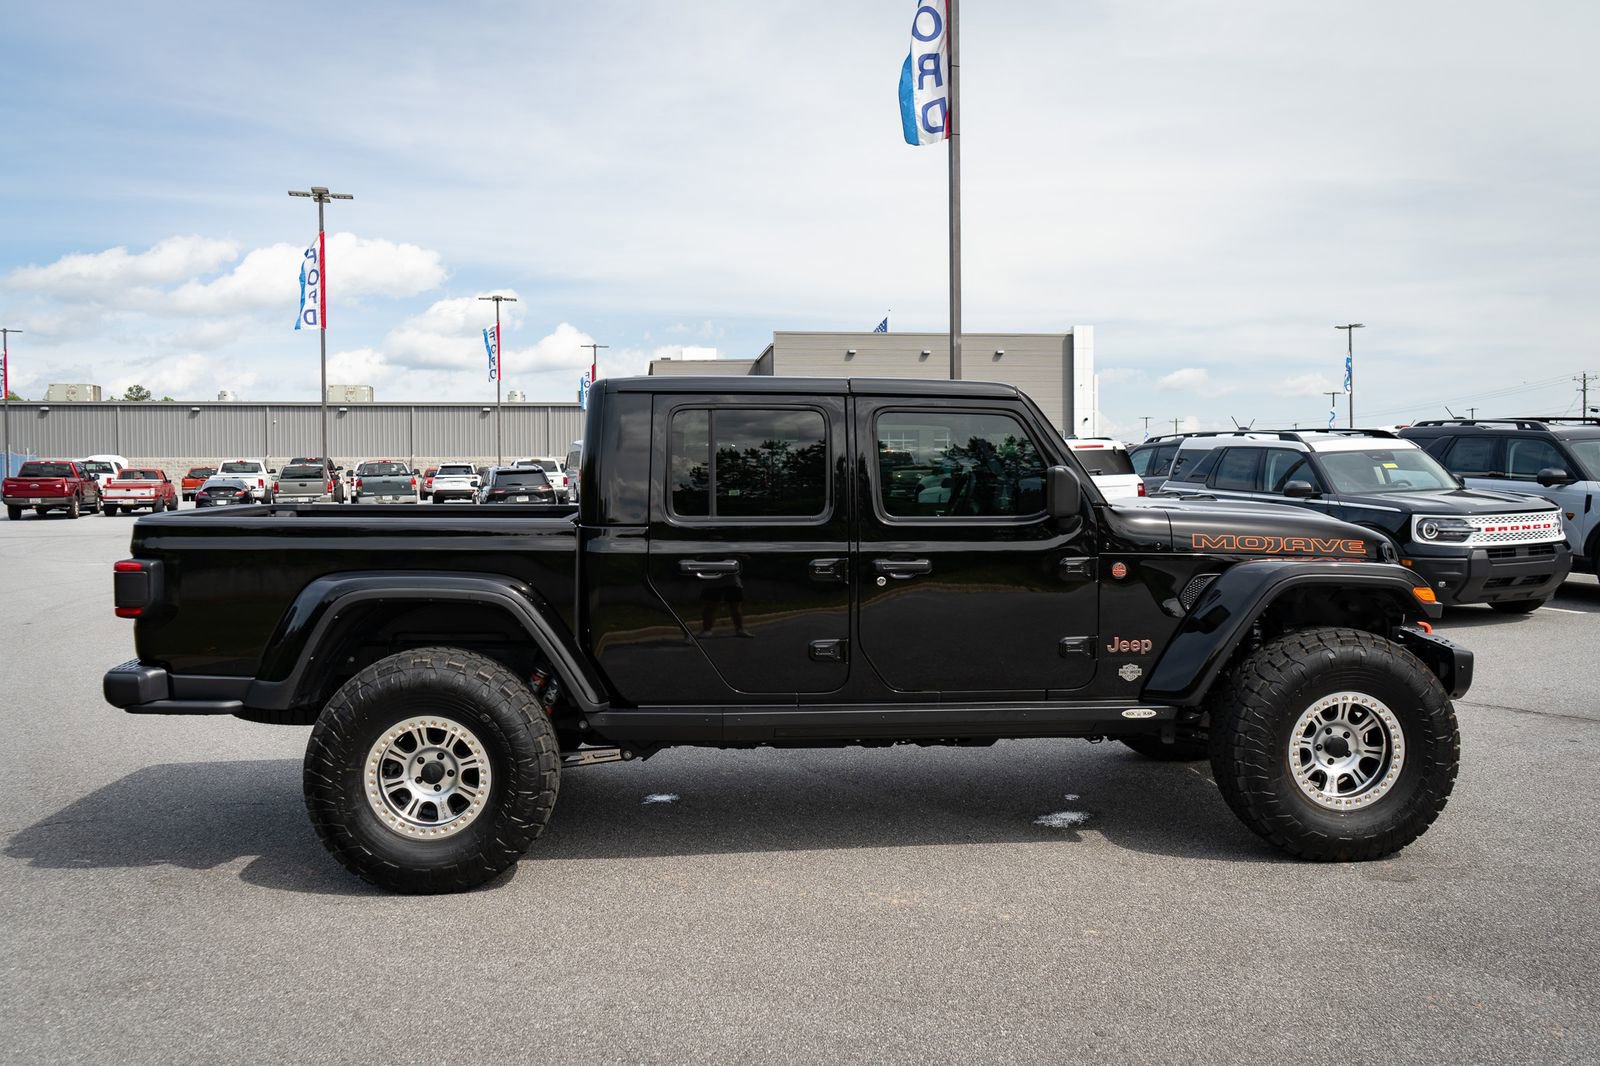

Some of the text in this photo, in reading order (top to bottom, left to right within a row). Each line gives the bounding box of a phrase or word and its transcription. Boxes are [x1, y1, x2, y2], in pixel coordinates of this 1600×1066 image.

[1485, 523, 1551, 532] BRONCO
[1192, 533, 1367, 554] MOJAVE
[1106, 636, 1153, 655] Jeep
